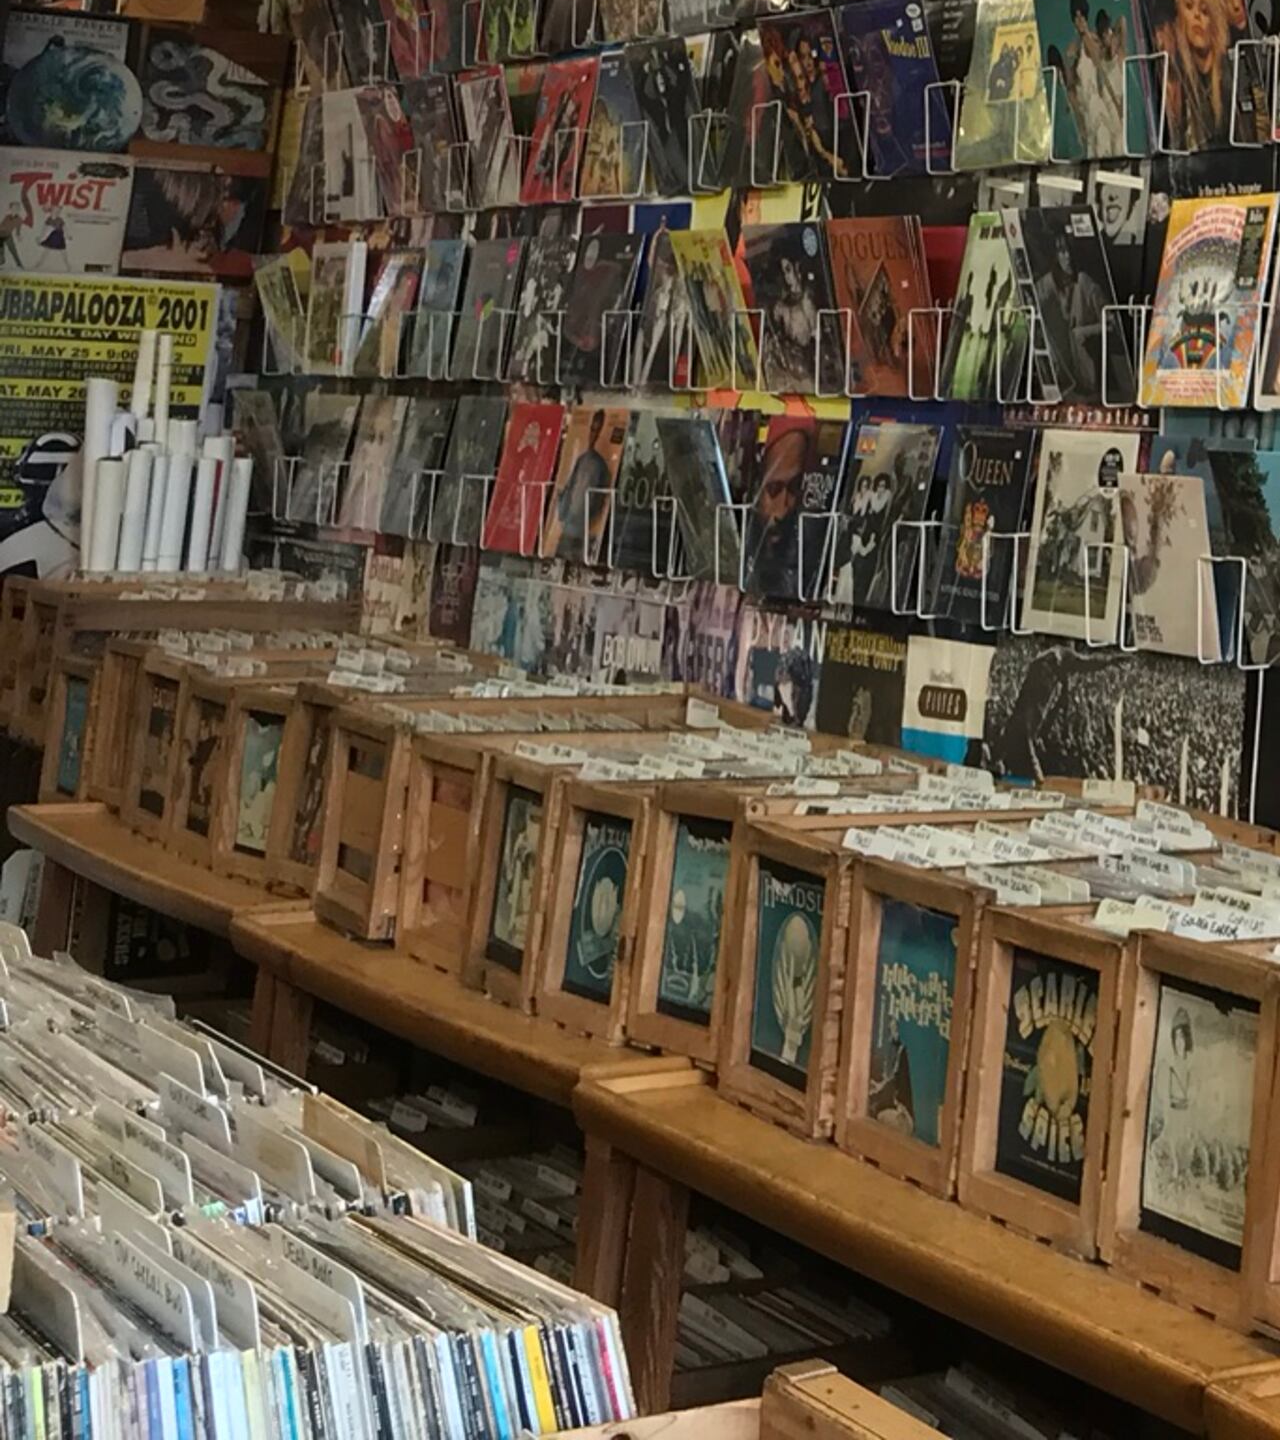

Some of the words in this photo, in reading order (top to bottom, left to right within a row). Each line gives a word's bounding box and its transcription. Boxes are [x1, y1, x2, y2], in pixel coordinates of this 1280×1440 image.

[156, 297, 210, 331] 2001
[81, 329, 112, 339] DAY
[31, 346, 66, 358] MAY
[71, 346, 90, 358] 25
[31, 386, 62, 398] MAY
[960, 441, 1013, 489] QUEEN
